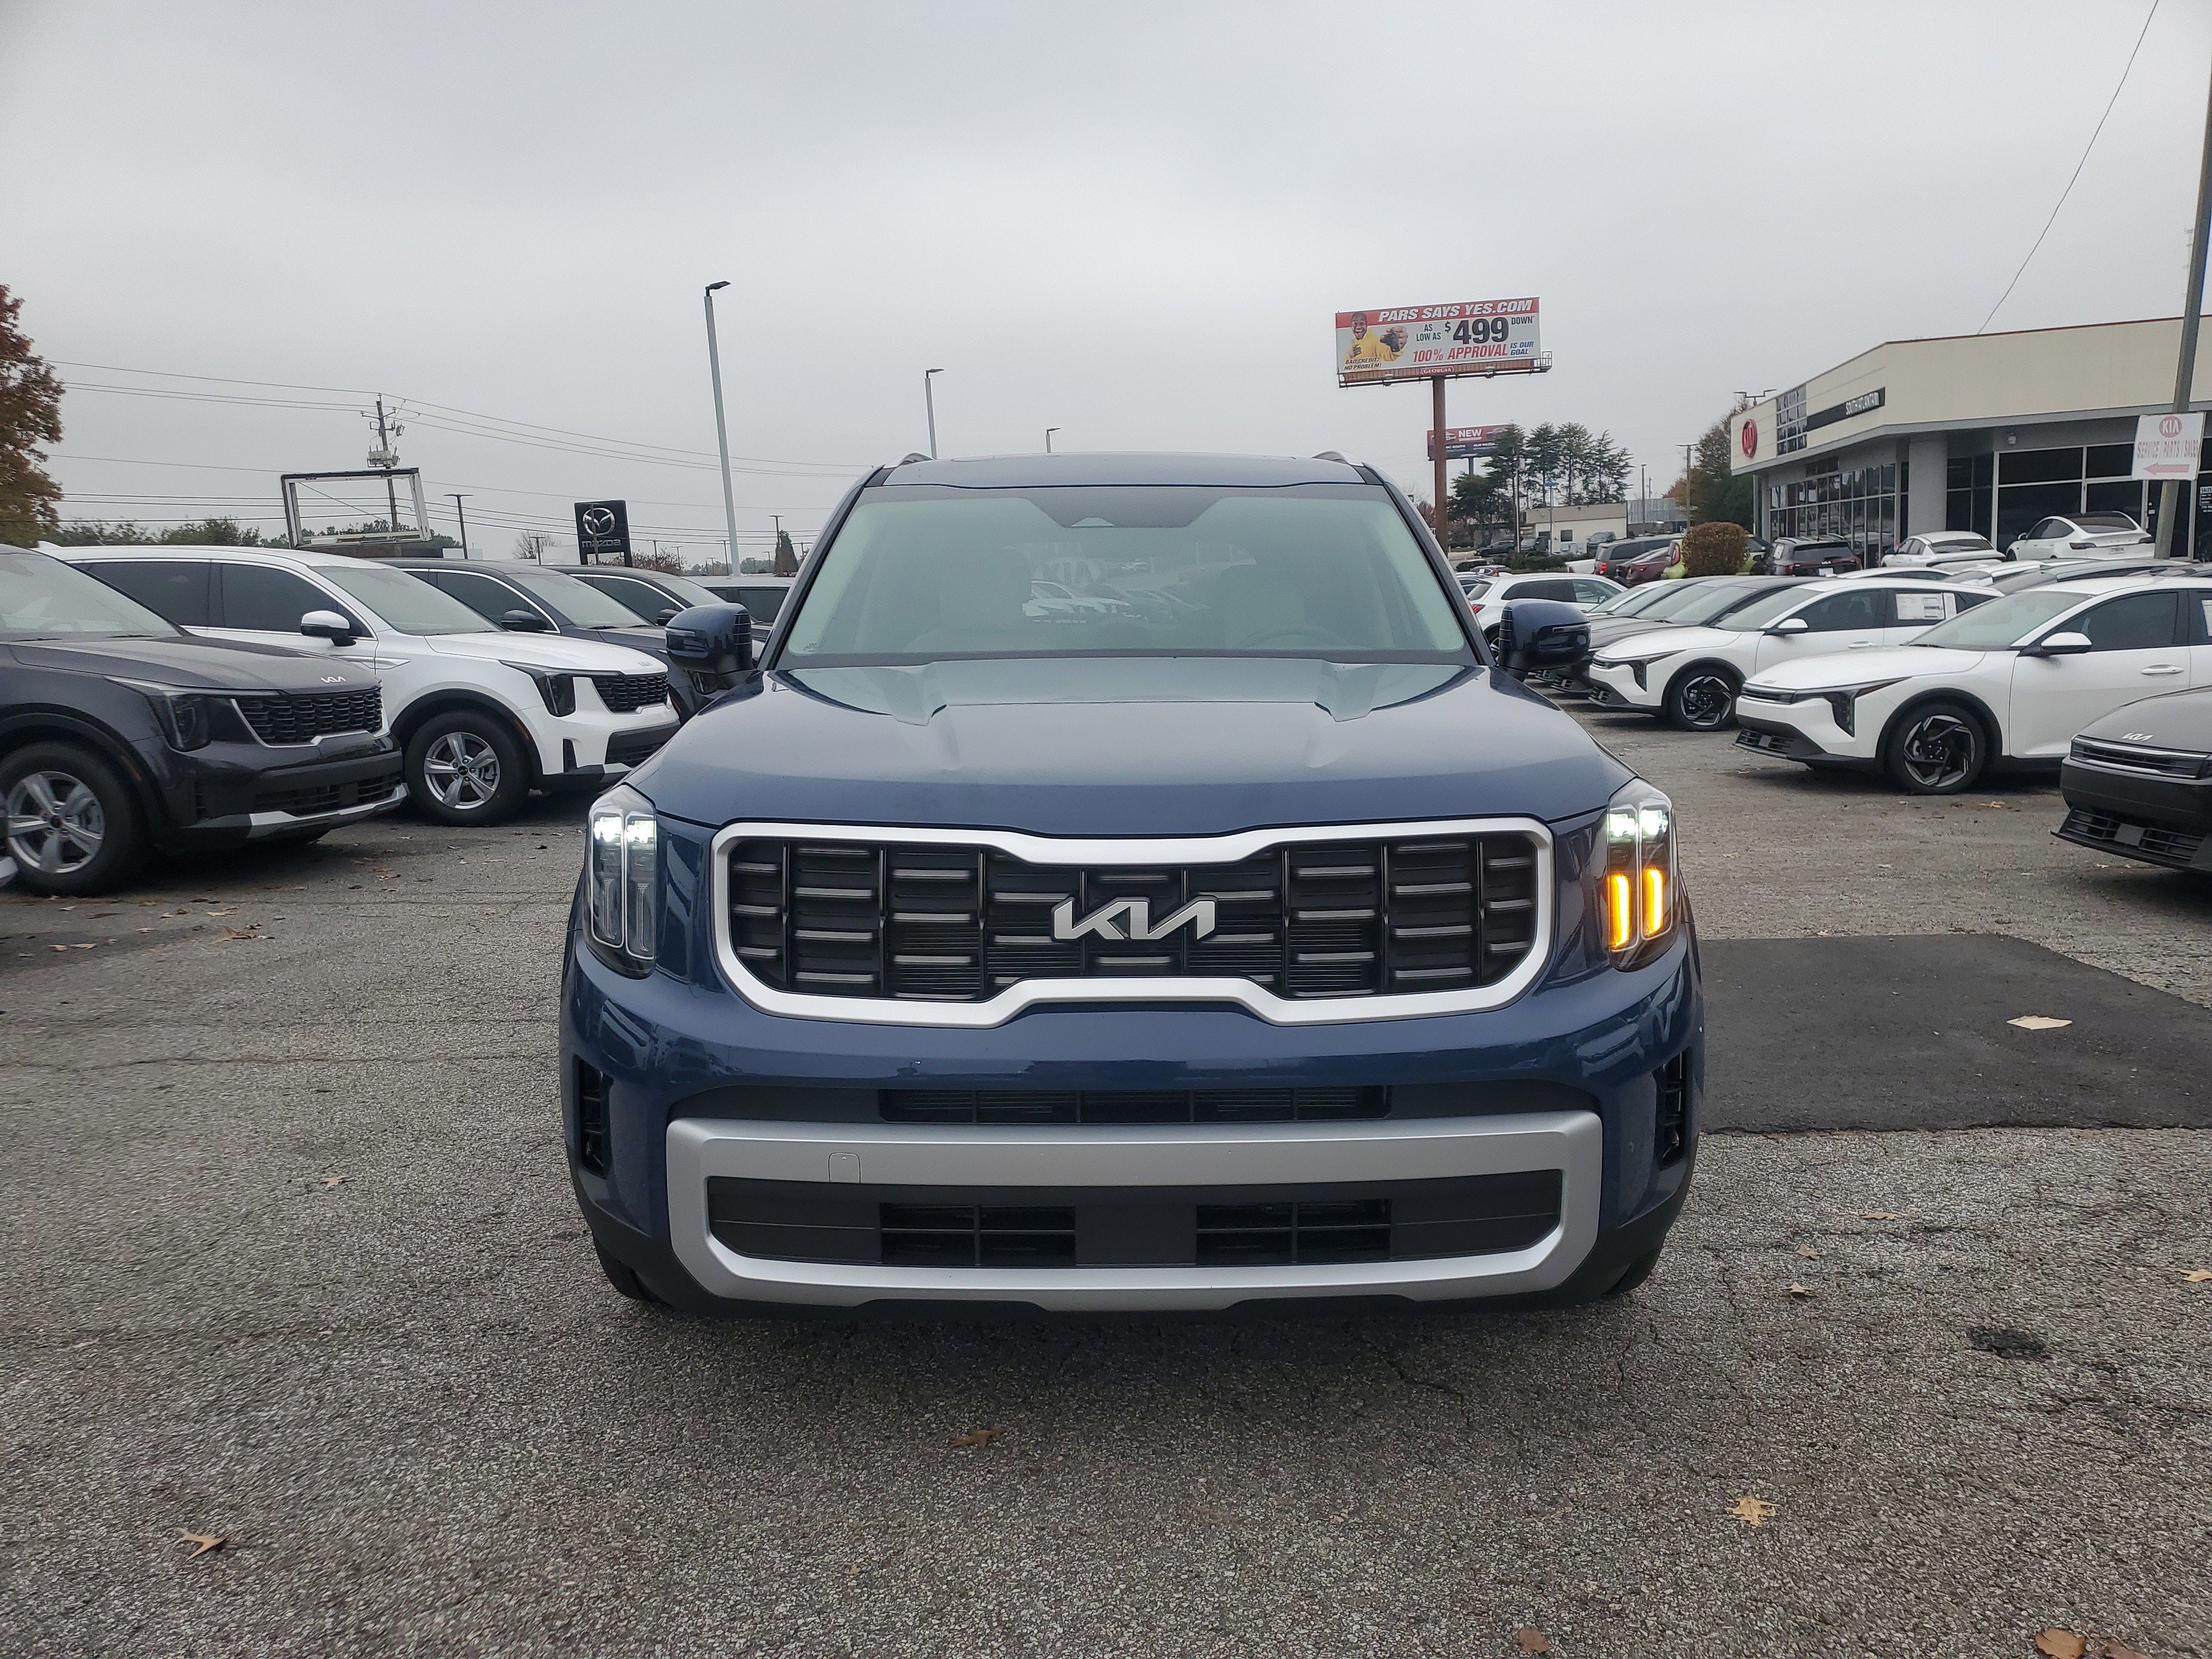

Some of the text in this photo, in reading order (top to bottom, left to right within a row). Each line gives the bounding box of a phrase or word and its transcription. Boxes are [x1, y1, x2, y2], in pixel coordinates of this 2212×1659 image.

[1378, 300, 1533, 322] PARS SAYS YES.COM
[1424, 324, 1433, 332] AS
[1416, 332, 1441, 342] LOW AS
[1413, 344, 1508, 363] 100% APPROVAL
[2163, 420, 2180, 433] KIA
[1458, 428, 1482, 437] NEW
[2121, 733, 2153, 741] KIA
[1053, 900, 1216, 940] KIA
